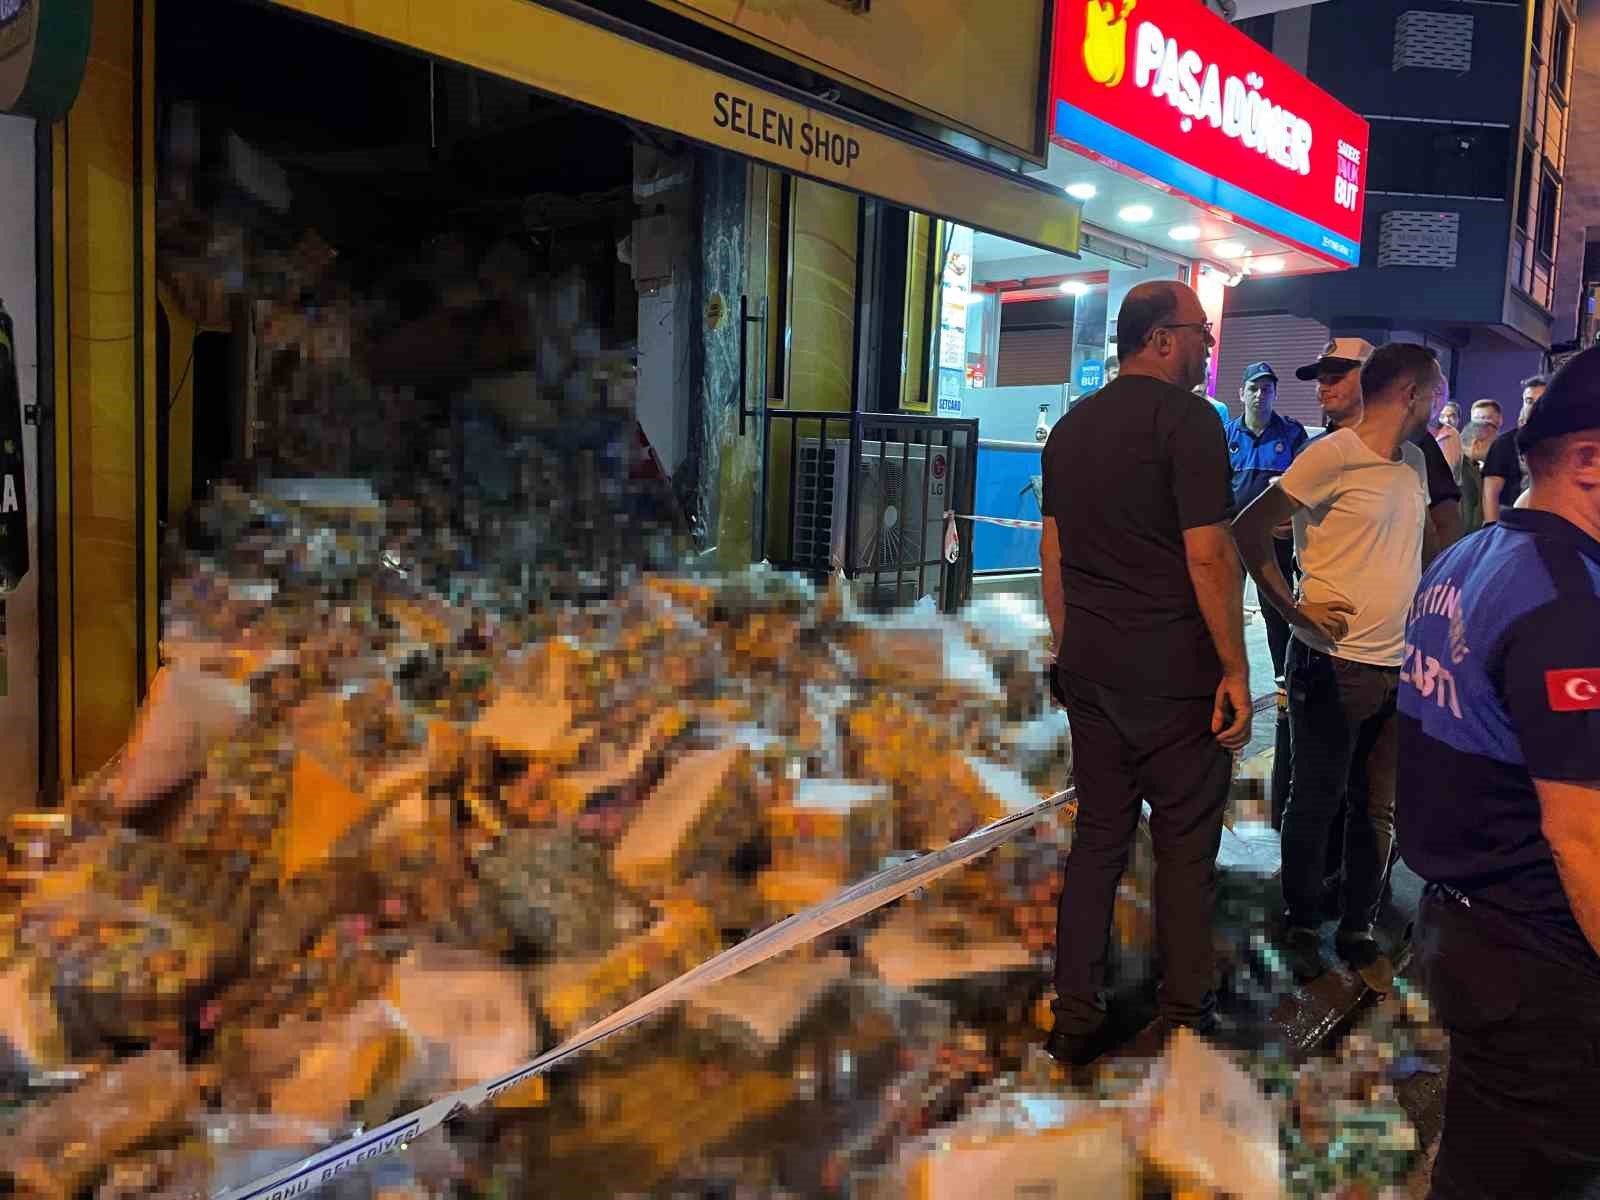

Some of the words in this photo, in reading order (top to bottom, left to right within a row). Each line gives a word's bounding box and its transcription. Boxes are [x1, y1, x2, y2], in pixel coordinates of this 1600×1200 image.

[1135, 21, 1222, 132] PAŞA
[1222, 71, 1312, 175] DÖNER
[713, 92, 793, 149] SELEN
[800, 122, 860, 168] SHOP
[1334, 174, 1359, 212] BUT
[1081, 376, 1100, 386] BUT
[931, 482, 943, 495] LG
